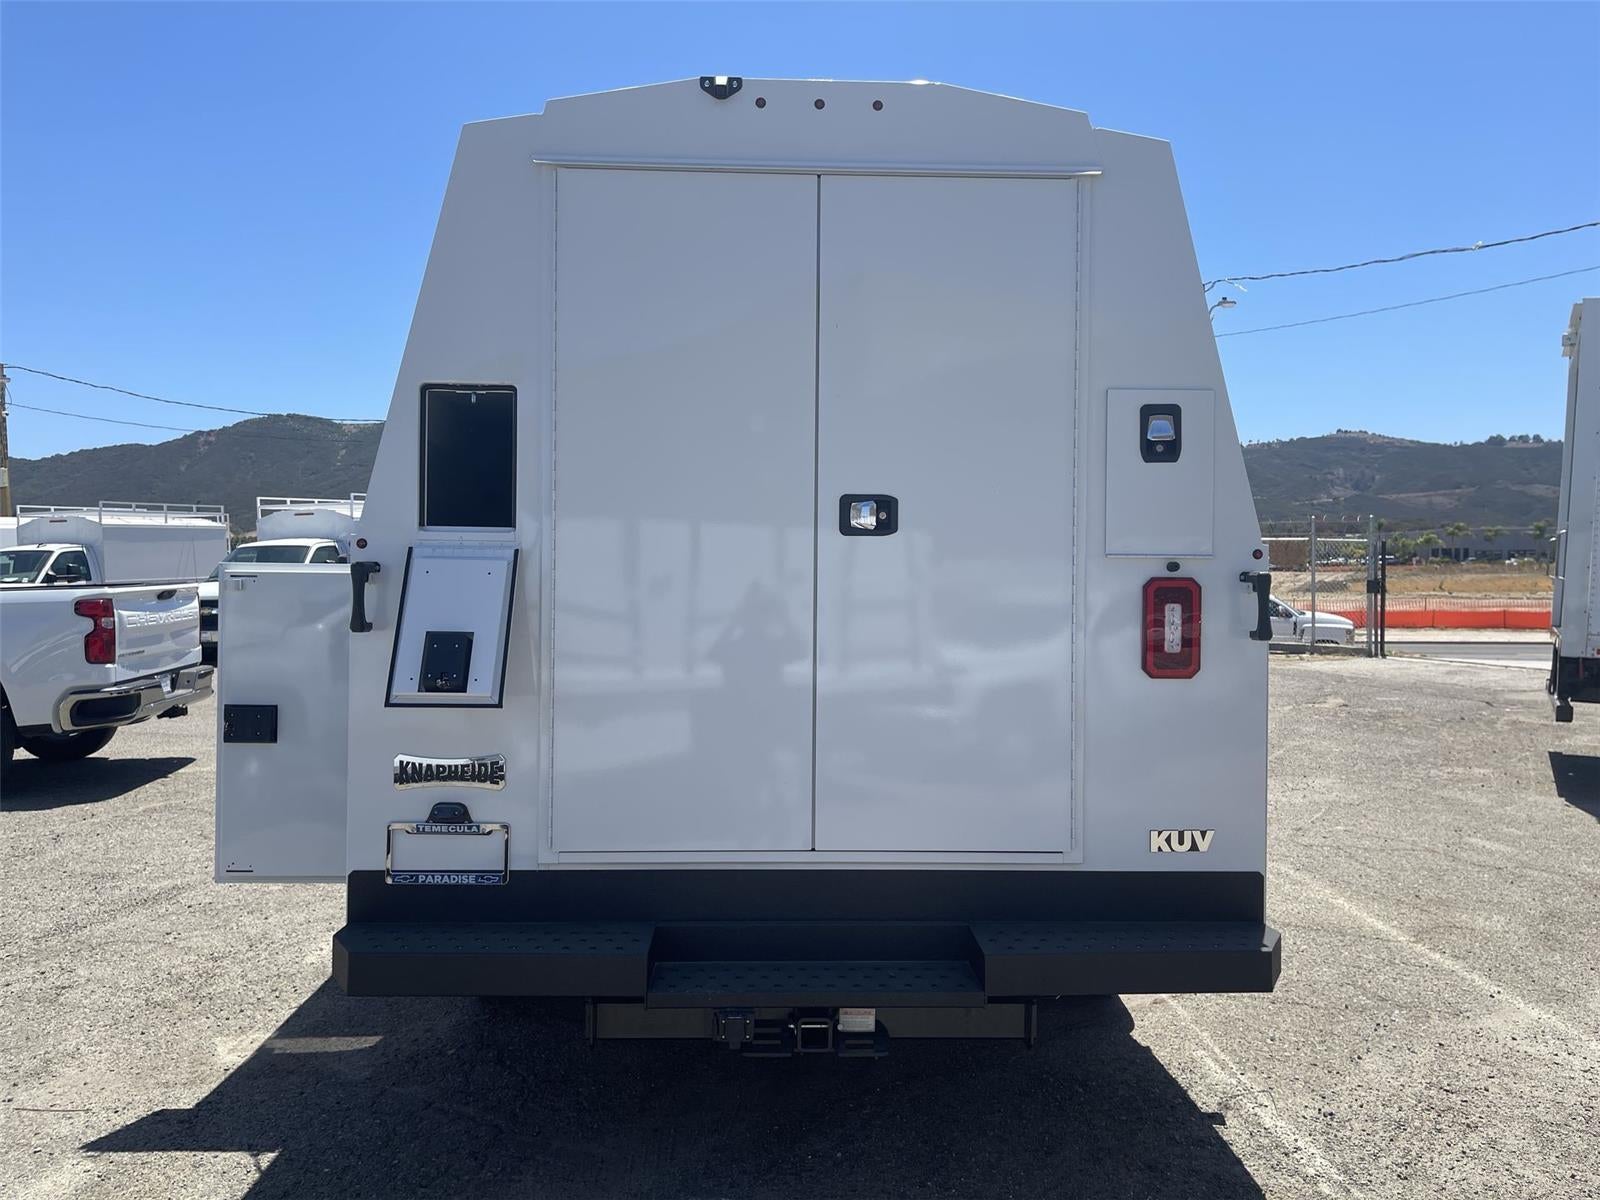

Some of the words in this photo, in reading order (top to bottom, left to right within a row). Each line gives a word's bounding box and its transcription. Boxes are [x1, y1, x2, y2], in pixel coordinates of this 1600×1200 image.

[398, 760, 500, 785] KNAPHEIDE
[418, 825, 478, 833] TEMECULA
[1150, 830, 1215, 853] KUV
[418, 875, 476, 884] PARADISE
